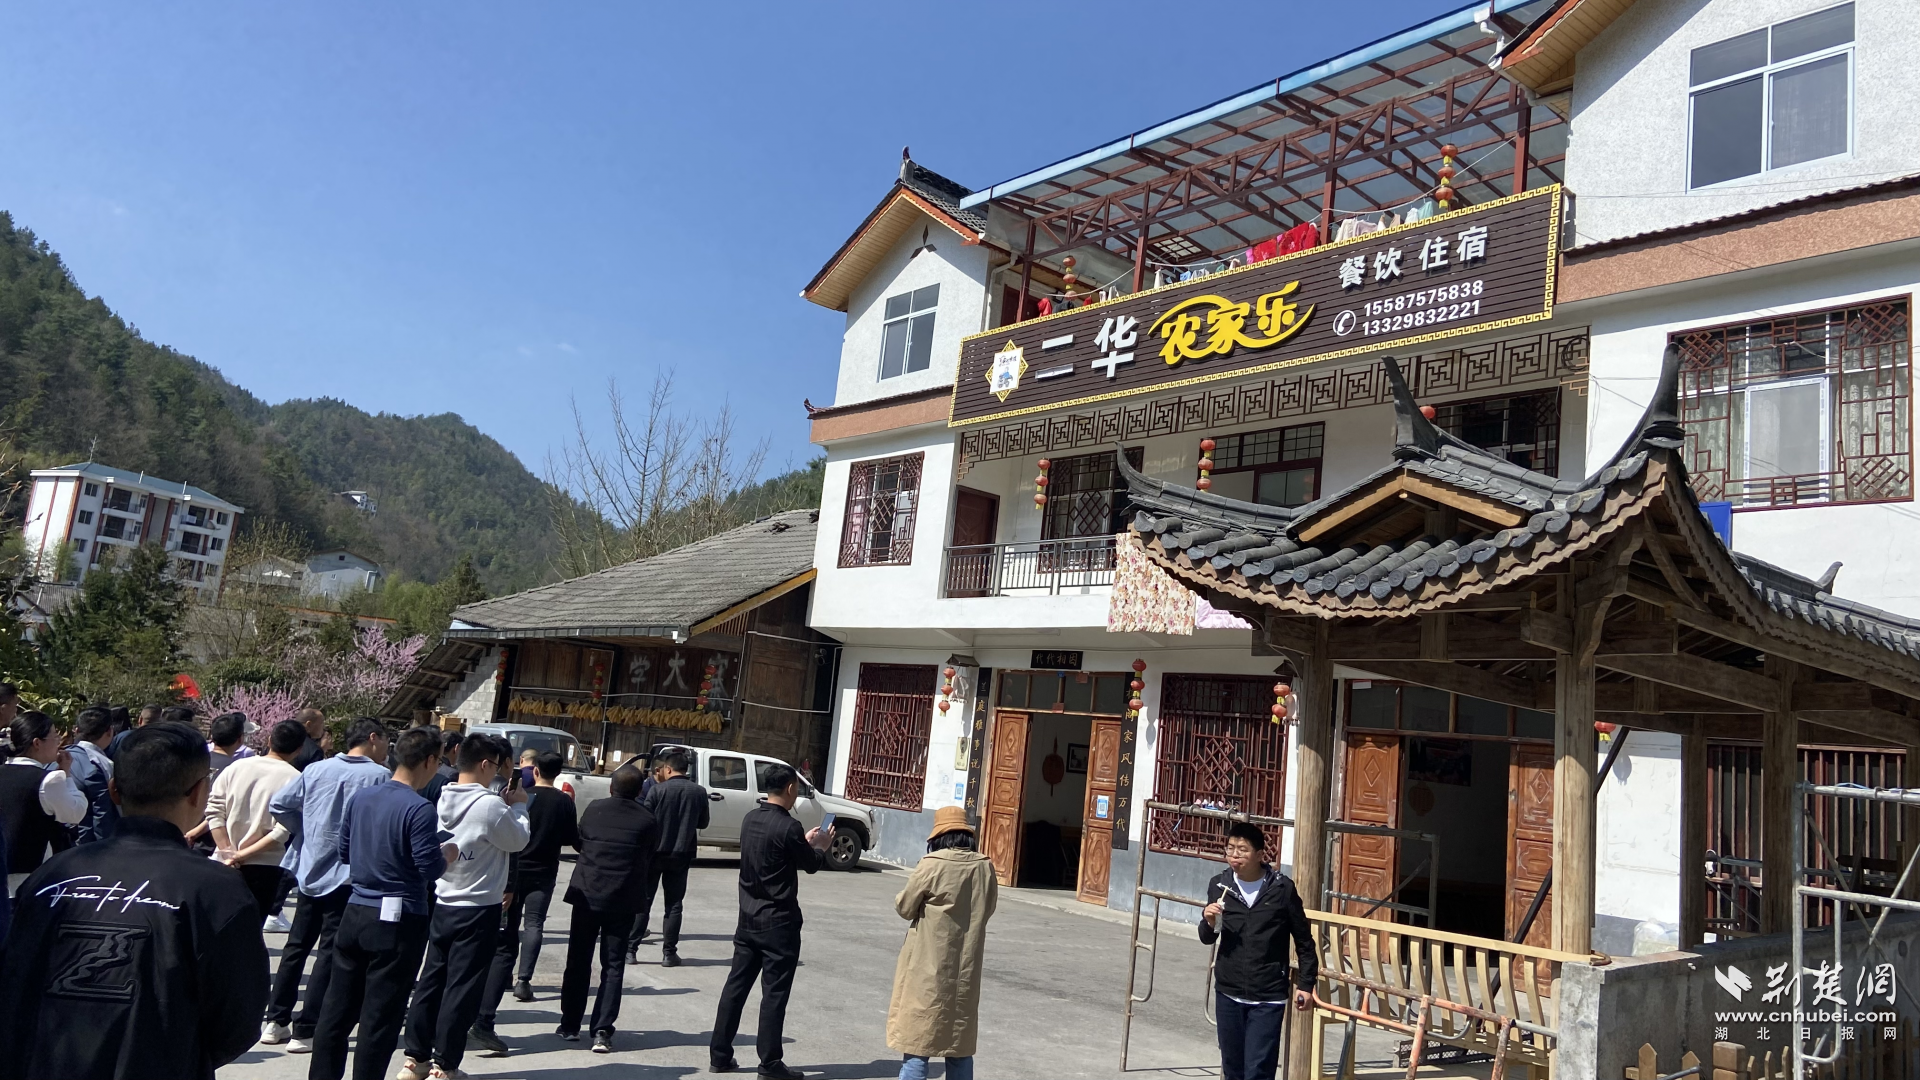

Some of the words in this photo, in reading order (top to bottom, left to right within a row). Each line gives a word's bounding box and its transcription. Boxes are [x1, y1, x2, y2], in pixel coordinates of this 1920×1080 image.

[1338, 247, 1404, 290] 餐饮
[1418, 225, 1490, 271] 住宿
[1362, 300, 1481, 336] 13329832221
[1363, 279, 1484, 318] 15587575838
[1148, 280, 1316, 367] 农家乐
[34, 874, 102, 908] Free
